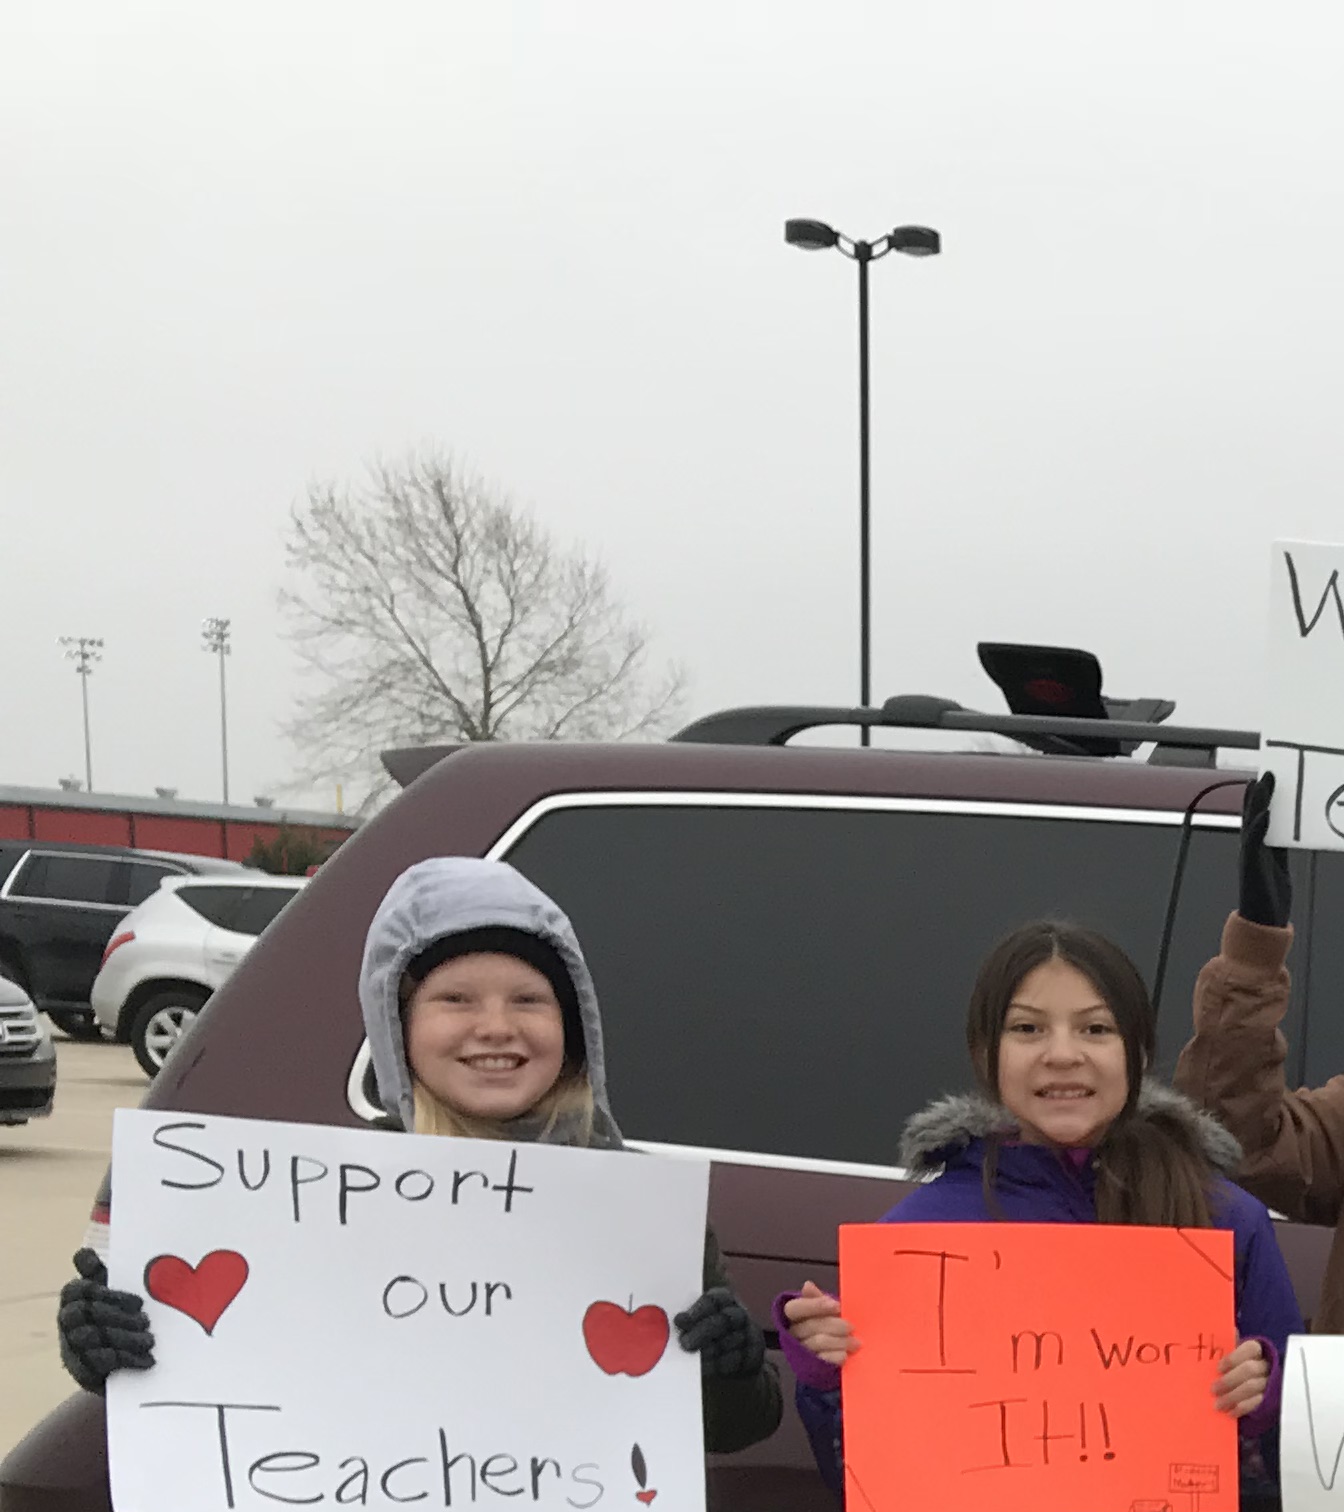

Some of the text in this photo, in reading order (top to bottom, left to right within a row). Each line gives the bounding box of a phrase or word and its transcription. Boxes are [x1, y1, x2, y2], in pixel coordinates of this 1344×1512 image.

[153, 1123, 533, 1223] Support
[382, 1276, 511, 1318] our
[894, 1250, 1063, 1374] I'm
[139, 1402, 658, 1510] Teachers!
